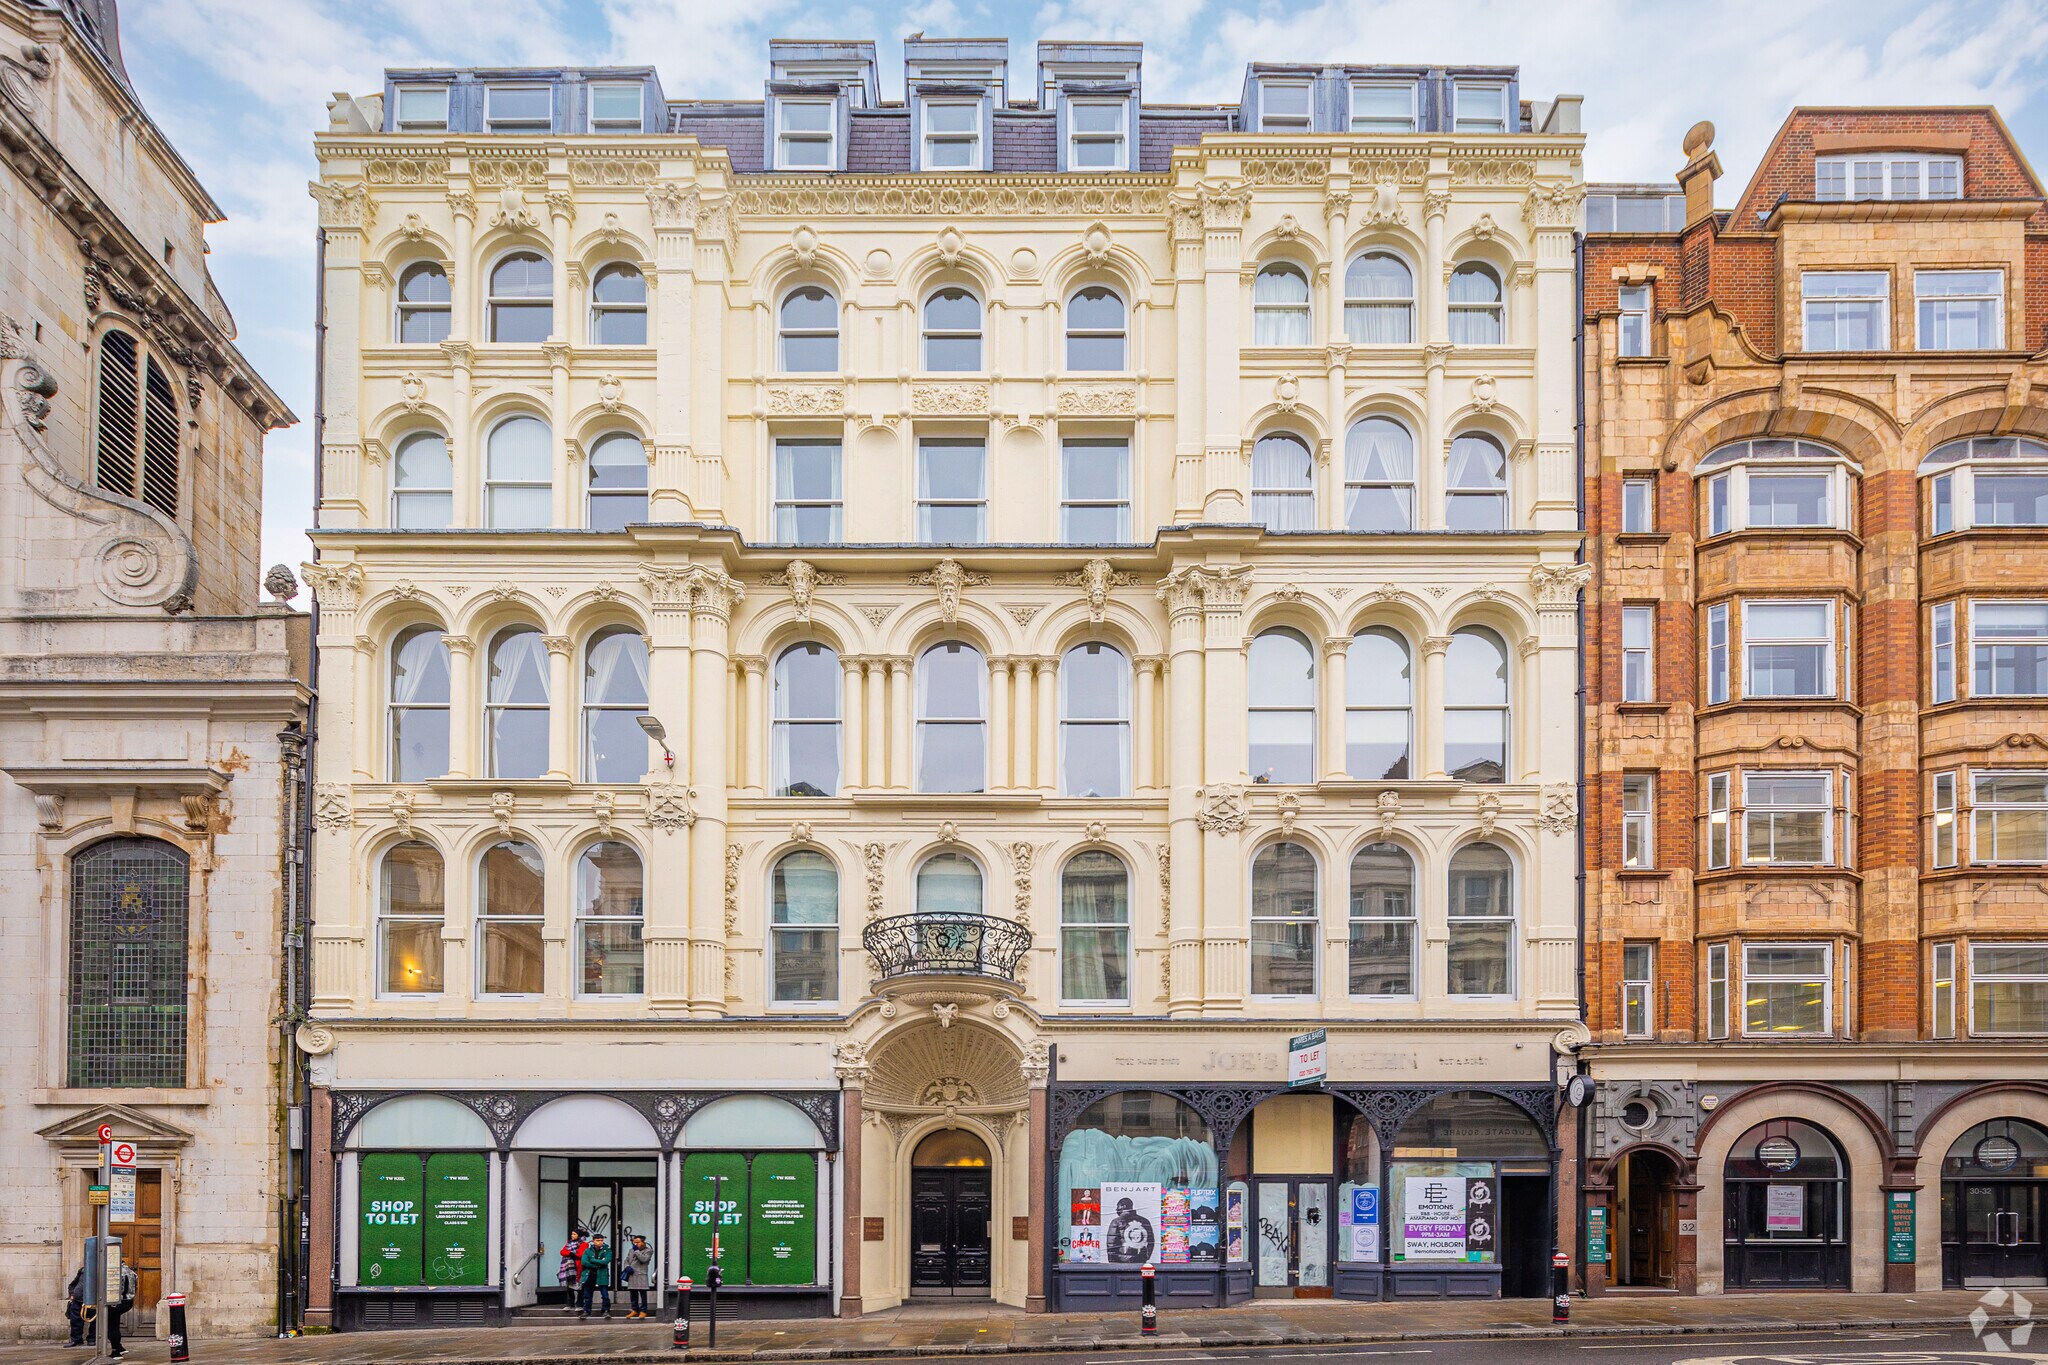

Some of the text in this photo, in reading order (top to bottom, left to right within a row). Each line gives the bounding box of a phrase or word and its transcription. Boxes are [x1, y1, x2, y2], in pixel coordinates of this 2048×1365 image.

[1300, 1050, 1319, 1063] TO LET
[102, 1127, 110, 1139] G
[371, 1201, 413, 1212] SHOP
[365, 1213, 419, 1225] TO LET
[689, 1213, 742, 1224] TO ET
[1682, 1223, 1694, 1231] 32
[1072, 1240, 1100, 1249] CAMPER
